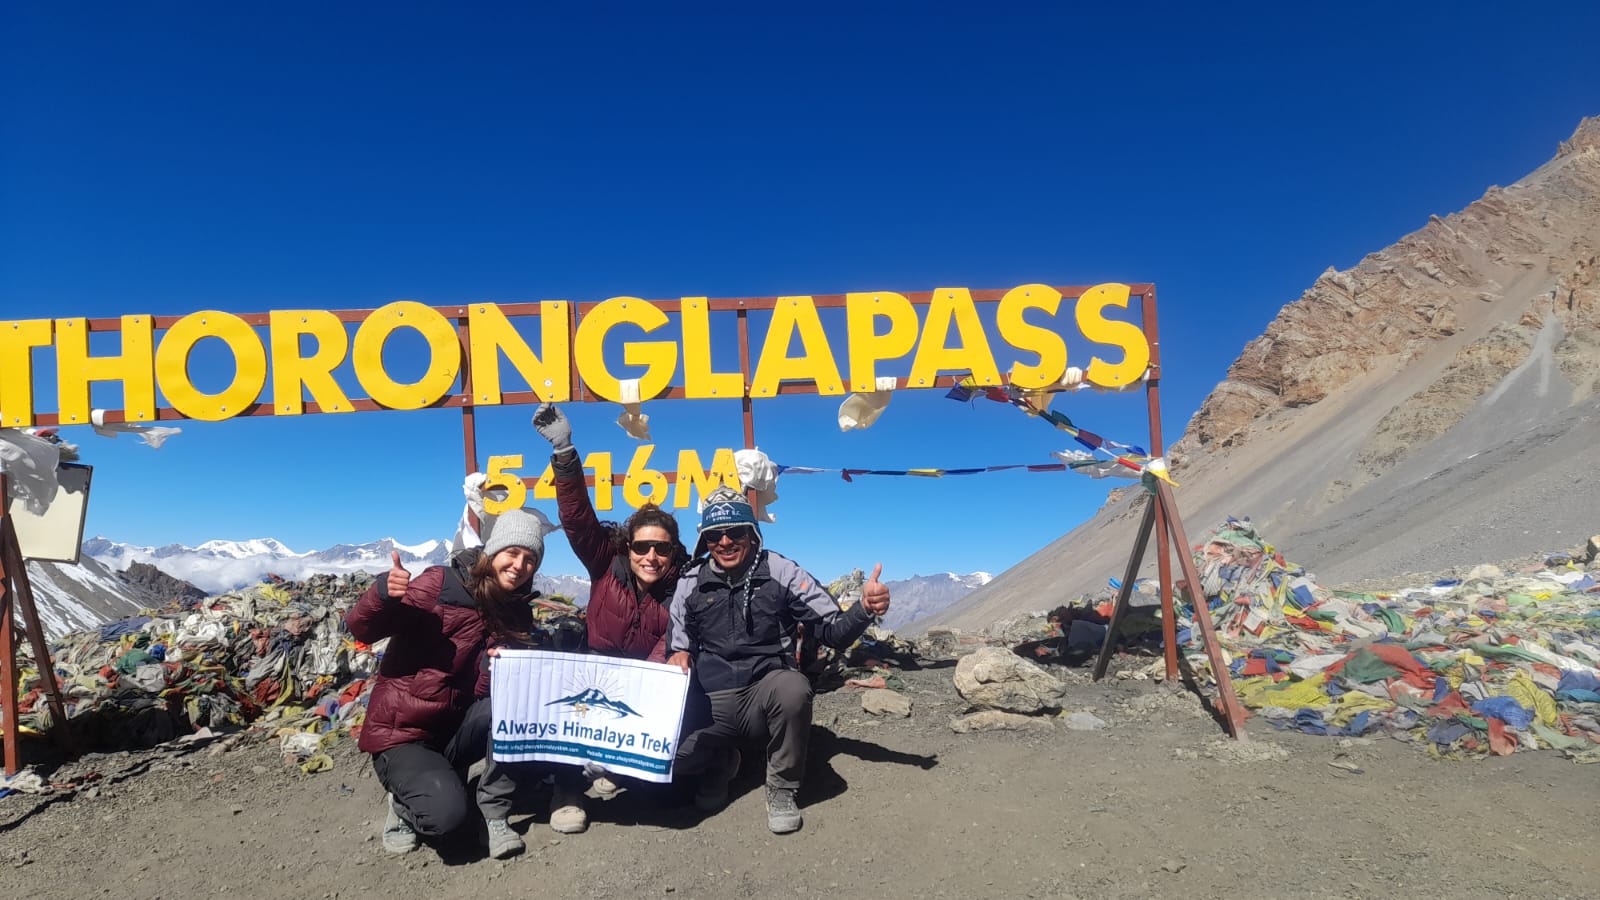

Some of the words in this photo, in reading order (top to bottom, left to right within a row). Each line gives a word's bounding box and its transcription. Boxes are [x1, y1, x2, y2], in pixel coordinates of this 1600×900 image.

[496, 719, 558, 739] Always
[563, 721, 636, 748] Himalaya
[640, 732, 672, 755] Trek
